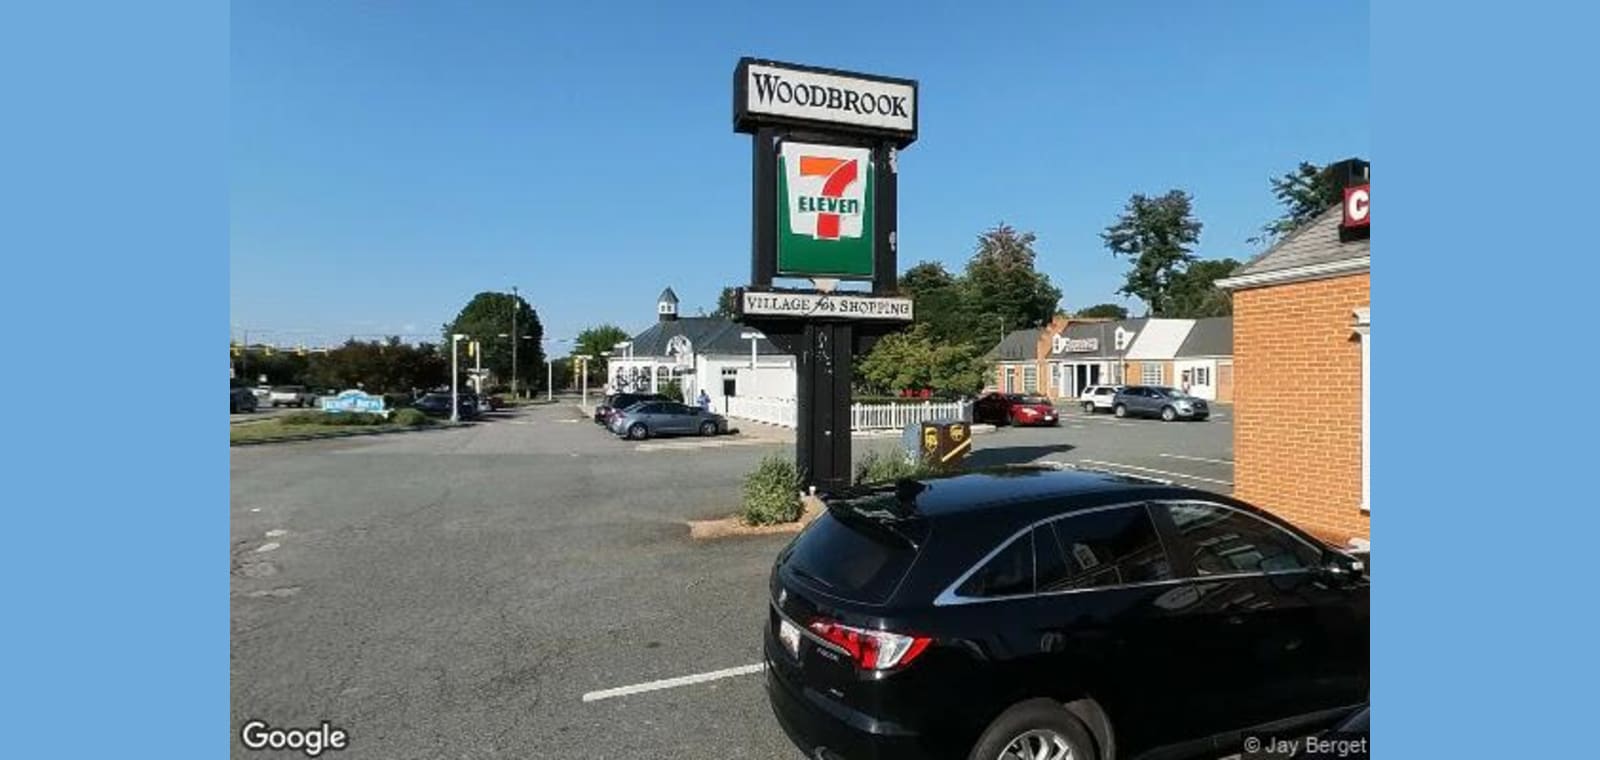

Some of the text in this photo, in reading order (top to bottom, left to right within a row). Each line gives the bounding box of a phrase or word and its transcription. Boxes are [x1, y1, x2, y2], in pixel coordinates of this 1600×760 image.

[752, 73, 908, 118] WOODBROOK
[800, 155, 858, 239] 7
[747, 295, 811, 311] VILLAGE
[839, 300, 909, 315] SHOPPING
